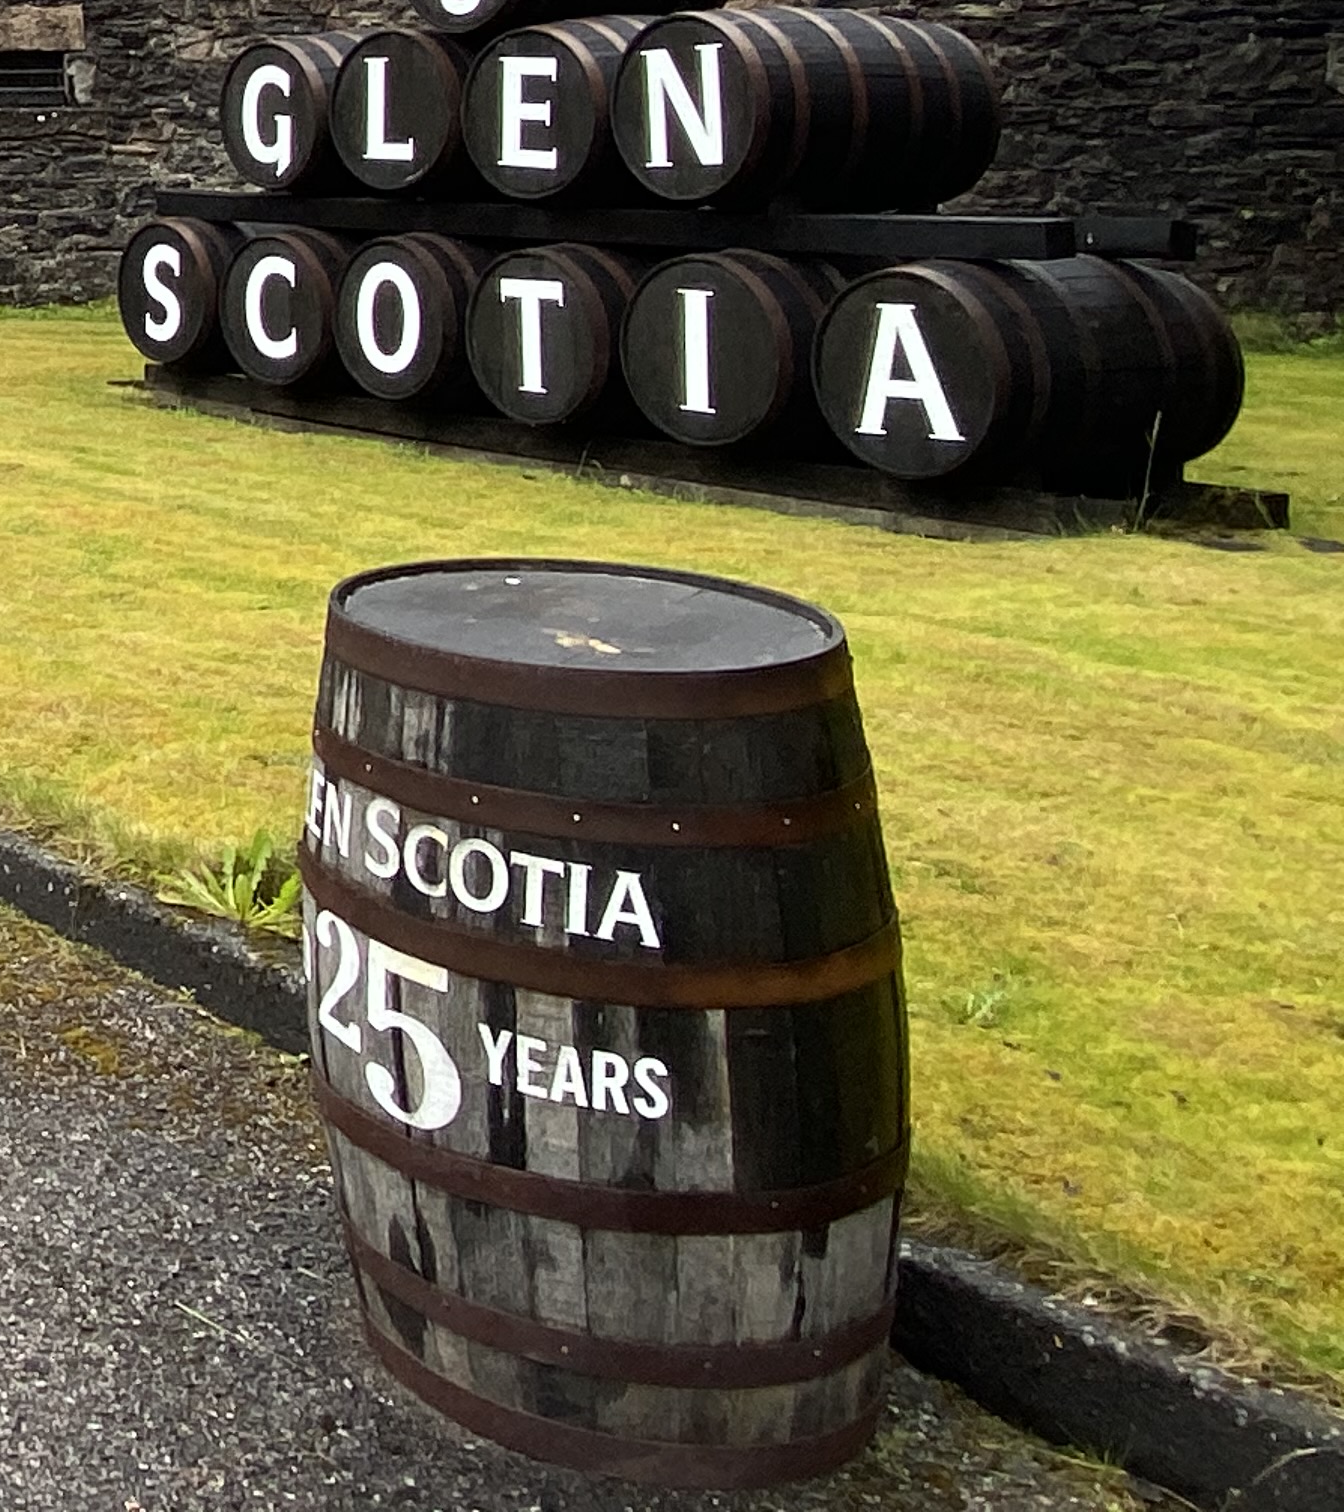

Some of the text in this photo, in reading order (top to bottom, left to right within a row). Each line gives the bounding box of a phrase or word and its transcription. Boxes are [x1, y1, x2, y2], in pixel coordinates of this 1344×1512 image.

[305, 769, 661, 949] EN SCOTIA
[478, 1022, 668, 1119] YEARS
